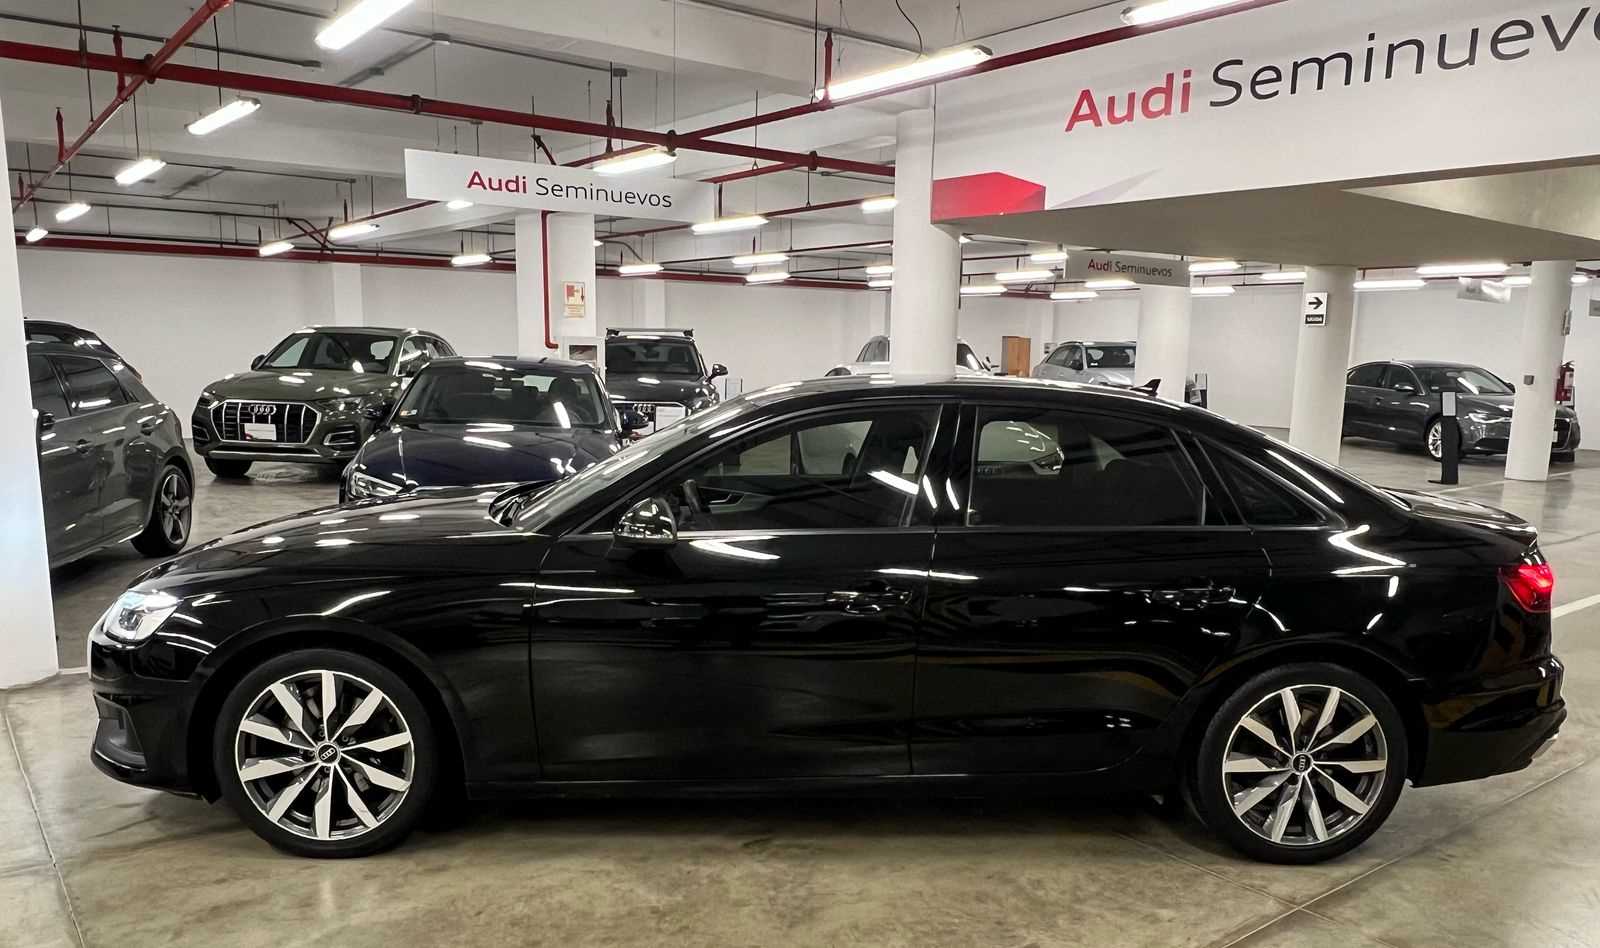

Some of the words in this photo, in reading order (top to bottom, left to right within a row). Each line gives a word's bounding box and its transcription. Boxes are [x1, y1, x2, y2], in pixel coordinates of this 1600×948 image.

[1066, 69, 1192, 132] Audi
[467, 170, 528, 194] Audi
[535, 177, 673, 208] Seminuevos
[1088, 258, 1112, 272] Audi
[1114, 261, 1173, 277] Seminuevos
